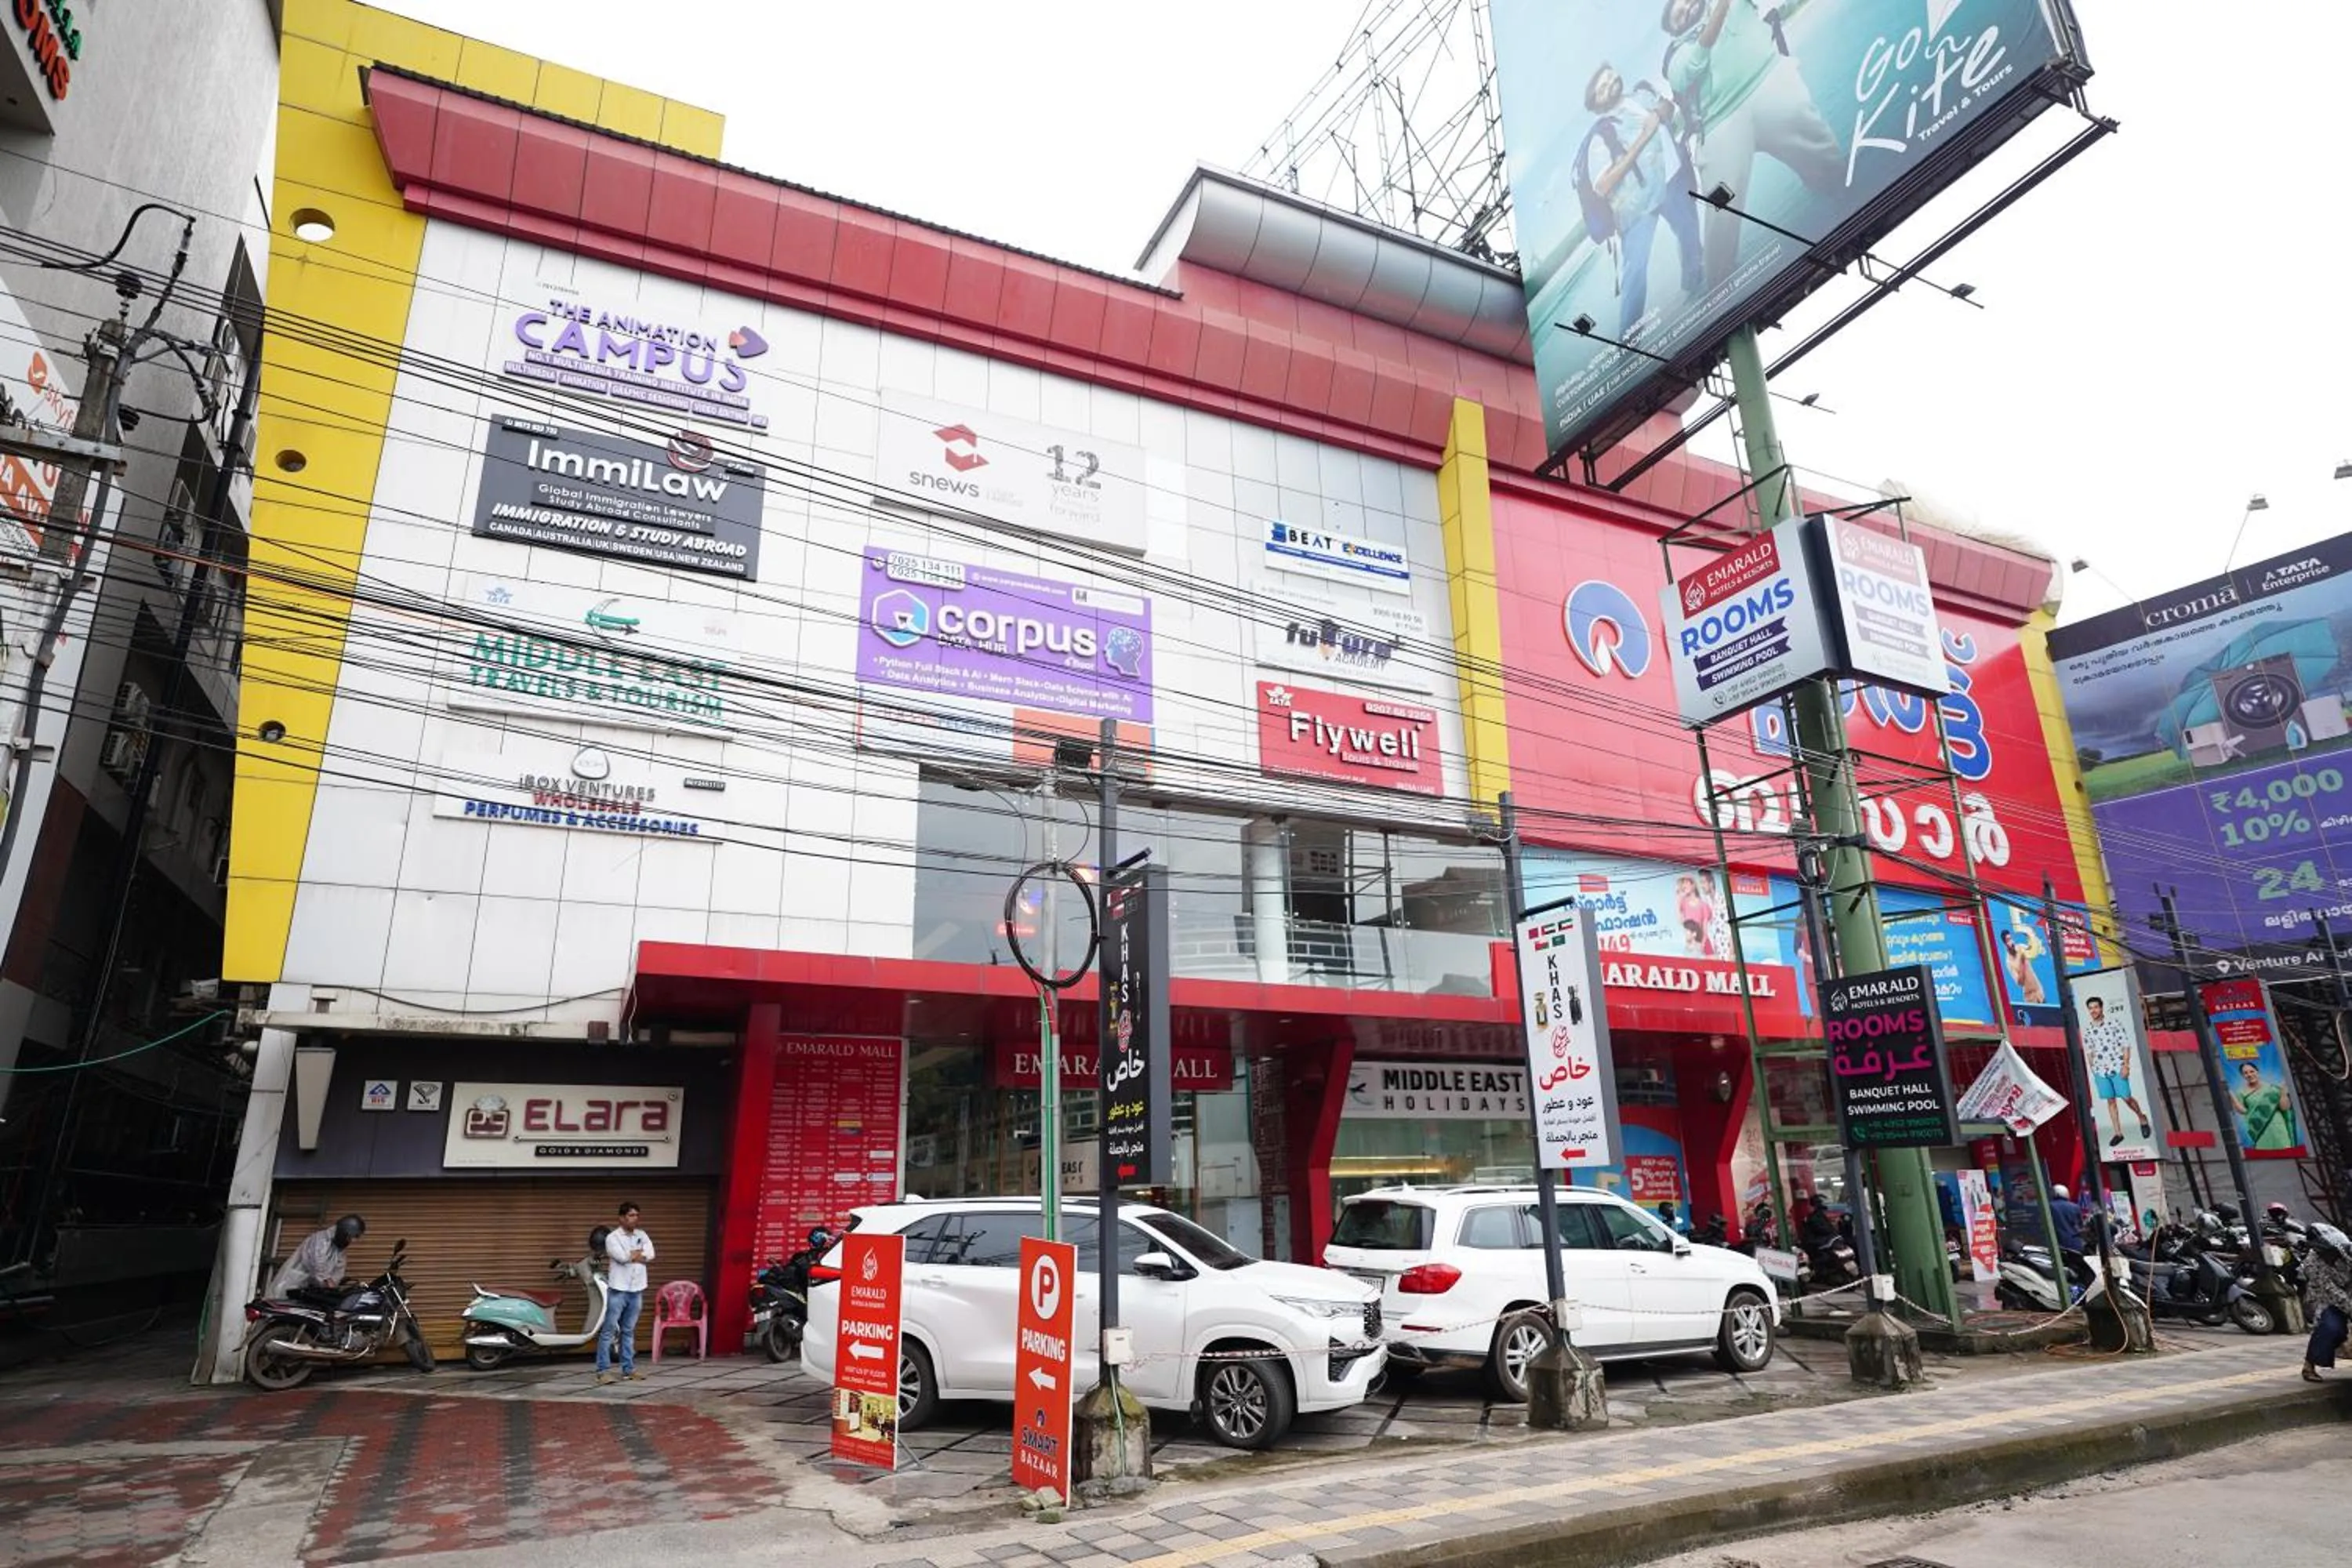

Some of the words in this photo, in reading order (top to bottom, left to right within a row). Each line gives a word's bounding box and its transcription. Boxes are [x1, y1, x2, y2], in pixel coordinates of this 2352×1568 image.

[1846, 25, 2007, 187] Kite
[1918, 104, 1959, 141] Travel
[1961, 96, 1972, 110] &
[1972, 63, 2014, 98] Tours
[549, 298, 592, 325] THE
[596, 312, 718, 353] ANIMATION
[514, 314, 750, 393] CAMPUS
[528, 439, 728, 503] ImmiLaw
[909, 470, 981, 499] snews
[1047, 445, 1102, 490] 12
[539, 483, 583, 499] Global
[586, 492, 660, 516] Immigration
[664, 505, 712, 523] Lawyers
[1051, 483, 1100, 503] years
[492, 502, 612, 534] IMMIGRATION
[614, 523, 627, 537] &
[630, 526, 683, 546] STUDY
[682, 535, 747, 558] ABROAD
[548, 494, 583, 510] Study
[586, 503, 630, 517] Abroad
[633, 510, 700, 530] Consultants
[701, 557, 744, 572] ZEALAND
[891, 554, 918, 568] 7025
[921, 561, 941, 572] 134
[1341, 543, 1403, 564] EXCELLENCE
[1707, 542, 1772, 587] EMARALD
[2265, 570, 2275, 582] A
[2276, 557, 2321, 576] TATA
[1710, 577, 1736, 598] HOTELS
[1742, 559, 1775, 582] RESORTS
[1840, 567, 1931, 617] ROOMS
[2261, 563, 2331, 592] Enterprise
[937, 604, 1098, 658] corpus
[1680, 577, 1795, 657] ROOMS
[1334, 652, 1388, 672] ACADEMY
[1709, 637, 1749, 665] BANQUET
[1748, 628, 1773, 648] HALL
[879, 655, 913, 669] Python
[914, 661, 934, 672] Full
[935, 664, 960, 677] Stack
[1711, 658, 1755, 684] SWIMMING
[1755, 646, 1780, 665] POOL
[470, 664, 576, 699] TRAVELS
[586, 684, 602, 700] &
[611, 684, 723, 717] TOURISM
[887, 669, 910, 681] Data
[912, 673, 956, 688] Analytics
[967, 681, 1011, 695] Business
[1089, 698, 1132, 716] Marketing
[1290, 710, 1420, 759] Flywell
[532, 789, 641, 815] WHOLESALE
[564, 779, 656, 802] VENTURES
[2209, 768, 2344, 814] ₹4,000
[464, 800, 562, 824] PERFUMES
[565, 811, 579, 826] &
[582, 812, 700, 836] ACCESSORIES
[2220, 808, 2312, 848] 10%
[2252, 860, 2326, 901] 24
[1120, 921, 1130, 1004] KHAS
[2234, 952, 2303, 973] Venture
[1546, 953, 1565, 1019] KHAS
[1848, 975, 1919, 1000] EMARALD
[1851, 1000, 1879, 1011] HOTELS
[1887, 993, 1920, 1007] RESORTS
[1828, 1007, 1926, 1044] ROOMS
[786, 1041, 855, 1057] EMARALD
[859, 1045, 896, 1058] MALL
[1106, 1047, 1145, 1092] خاص
[1173, 1058, 1218, 1079] ALL
[1382, 1068, 1465, 1092] MIDDLE
[1470, 1071, 1523, 1092] EAST
[1538, 1055, 1592, 1091] خاص
[1383, 1095, 1526, 1113] HOLIDAYS
[1846, 1101, 1906, 1116] SWIMMING
[1907, 1099, 1940, 1111] POOL
[1849, 1083, 1900, 1100] BANQUET
[1902, 1082, 1933, 1095] HALL
[539, 1146, 571, 1156] GOLD
[574, 1147, 581, 1156] &
[583, 1147, 648, 1156] DIAMONDS
[851, 1285, 887, 1301] EMARALD
[1039, 1265, 1056, 1308] P
[840, 1319, 895, 1341] PARKING
[1021, 1327, 1067, 1363] PARKING
[1021, 1426, 1059, 1457] SMART
[1019, 1450, 1059, 1481] BAZAAR
